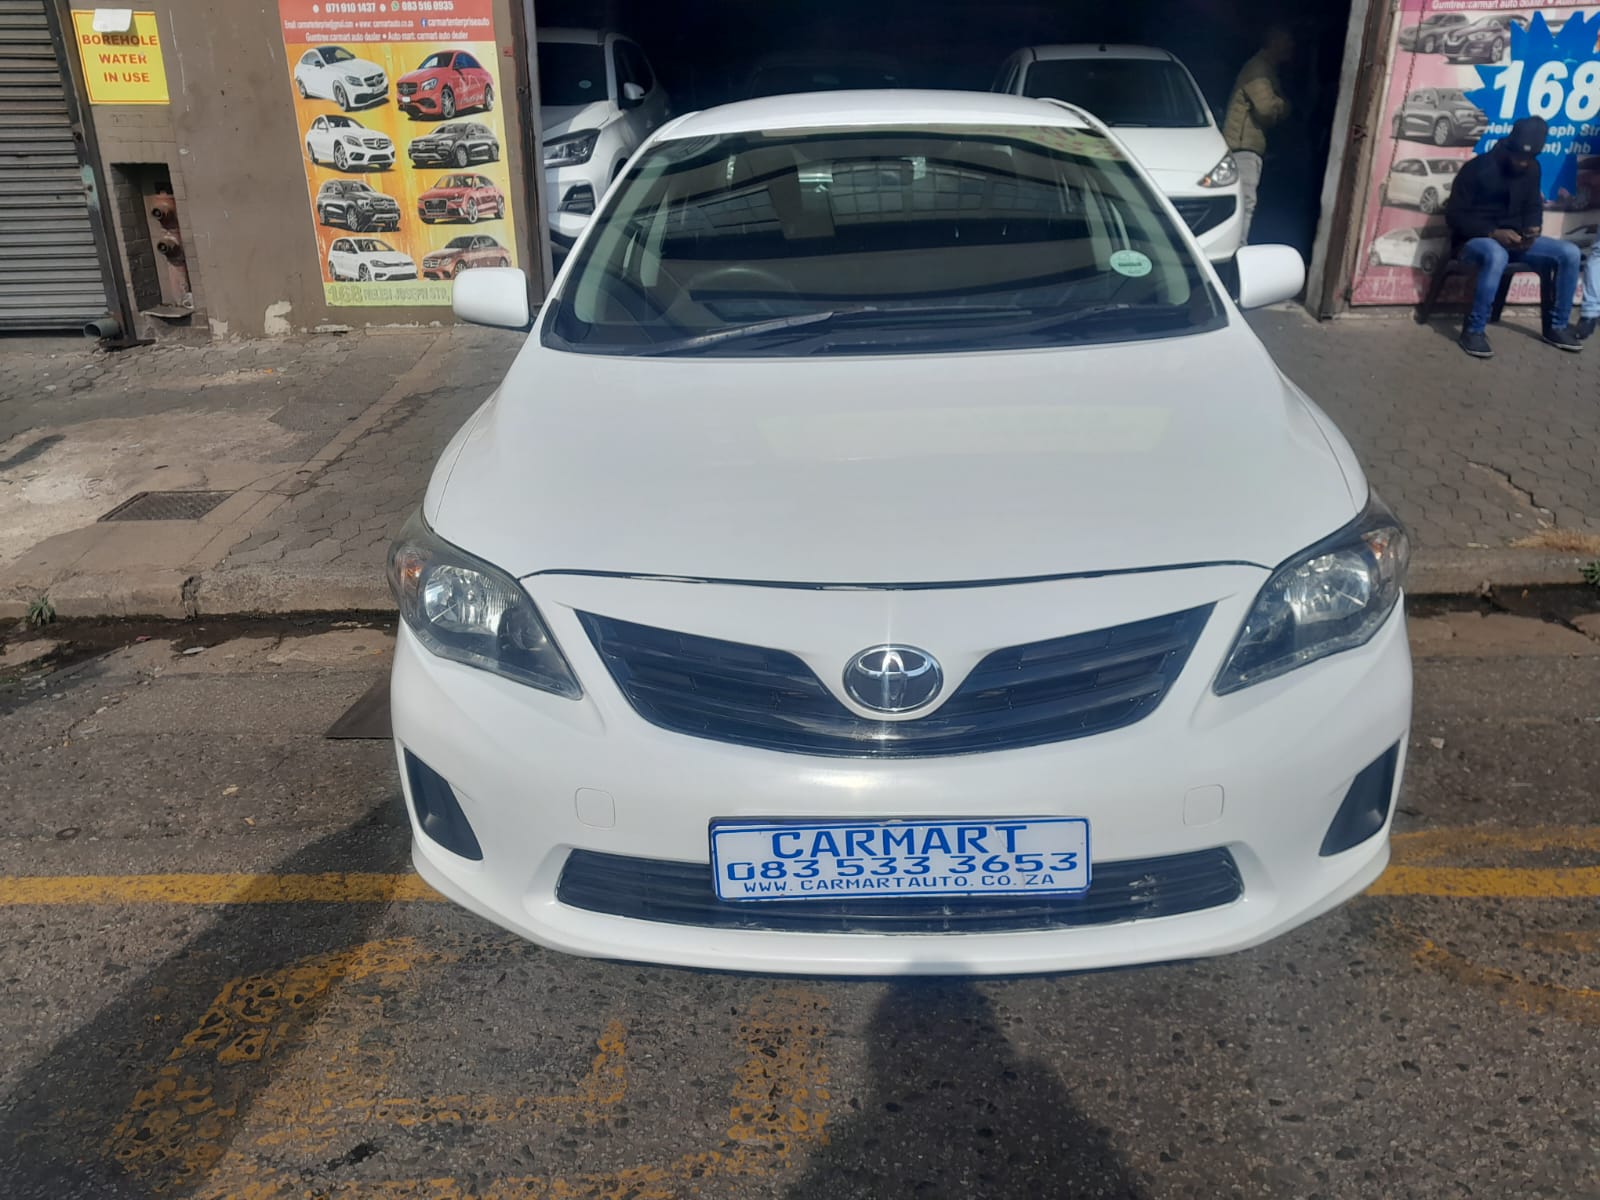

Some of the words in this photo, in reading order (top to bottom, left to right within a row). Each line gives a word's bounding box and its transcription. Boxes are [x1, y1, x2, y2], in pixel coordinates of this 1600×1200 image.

[325, 3, 340, 13] 071
[82, 34, 158, 46] BOREHOLE
[99, 53, 148, 65] WATER
[103, 71, 118, 82] IN
[122, 72, 151, 83] USE
[1493, 60, 1600, 122] 168
[771, 824, 1028, 859] CARMART
[726, 858, 820, 881] 083
[836, 854, 931, 877] 533
[948, 852, 1078, 875] 3653
